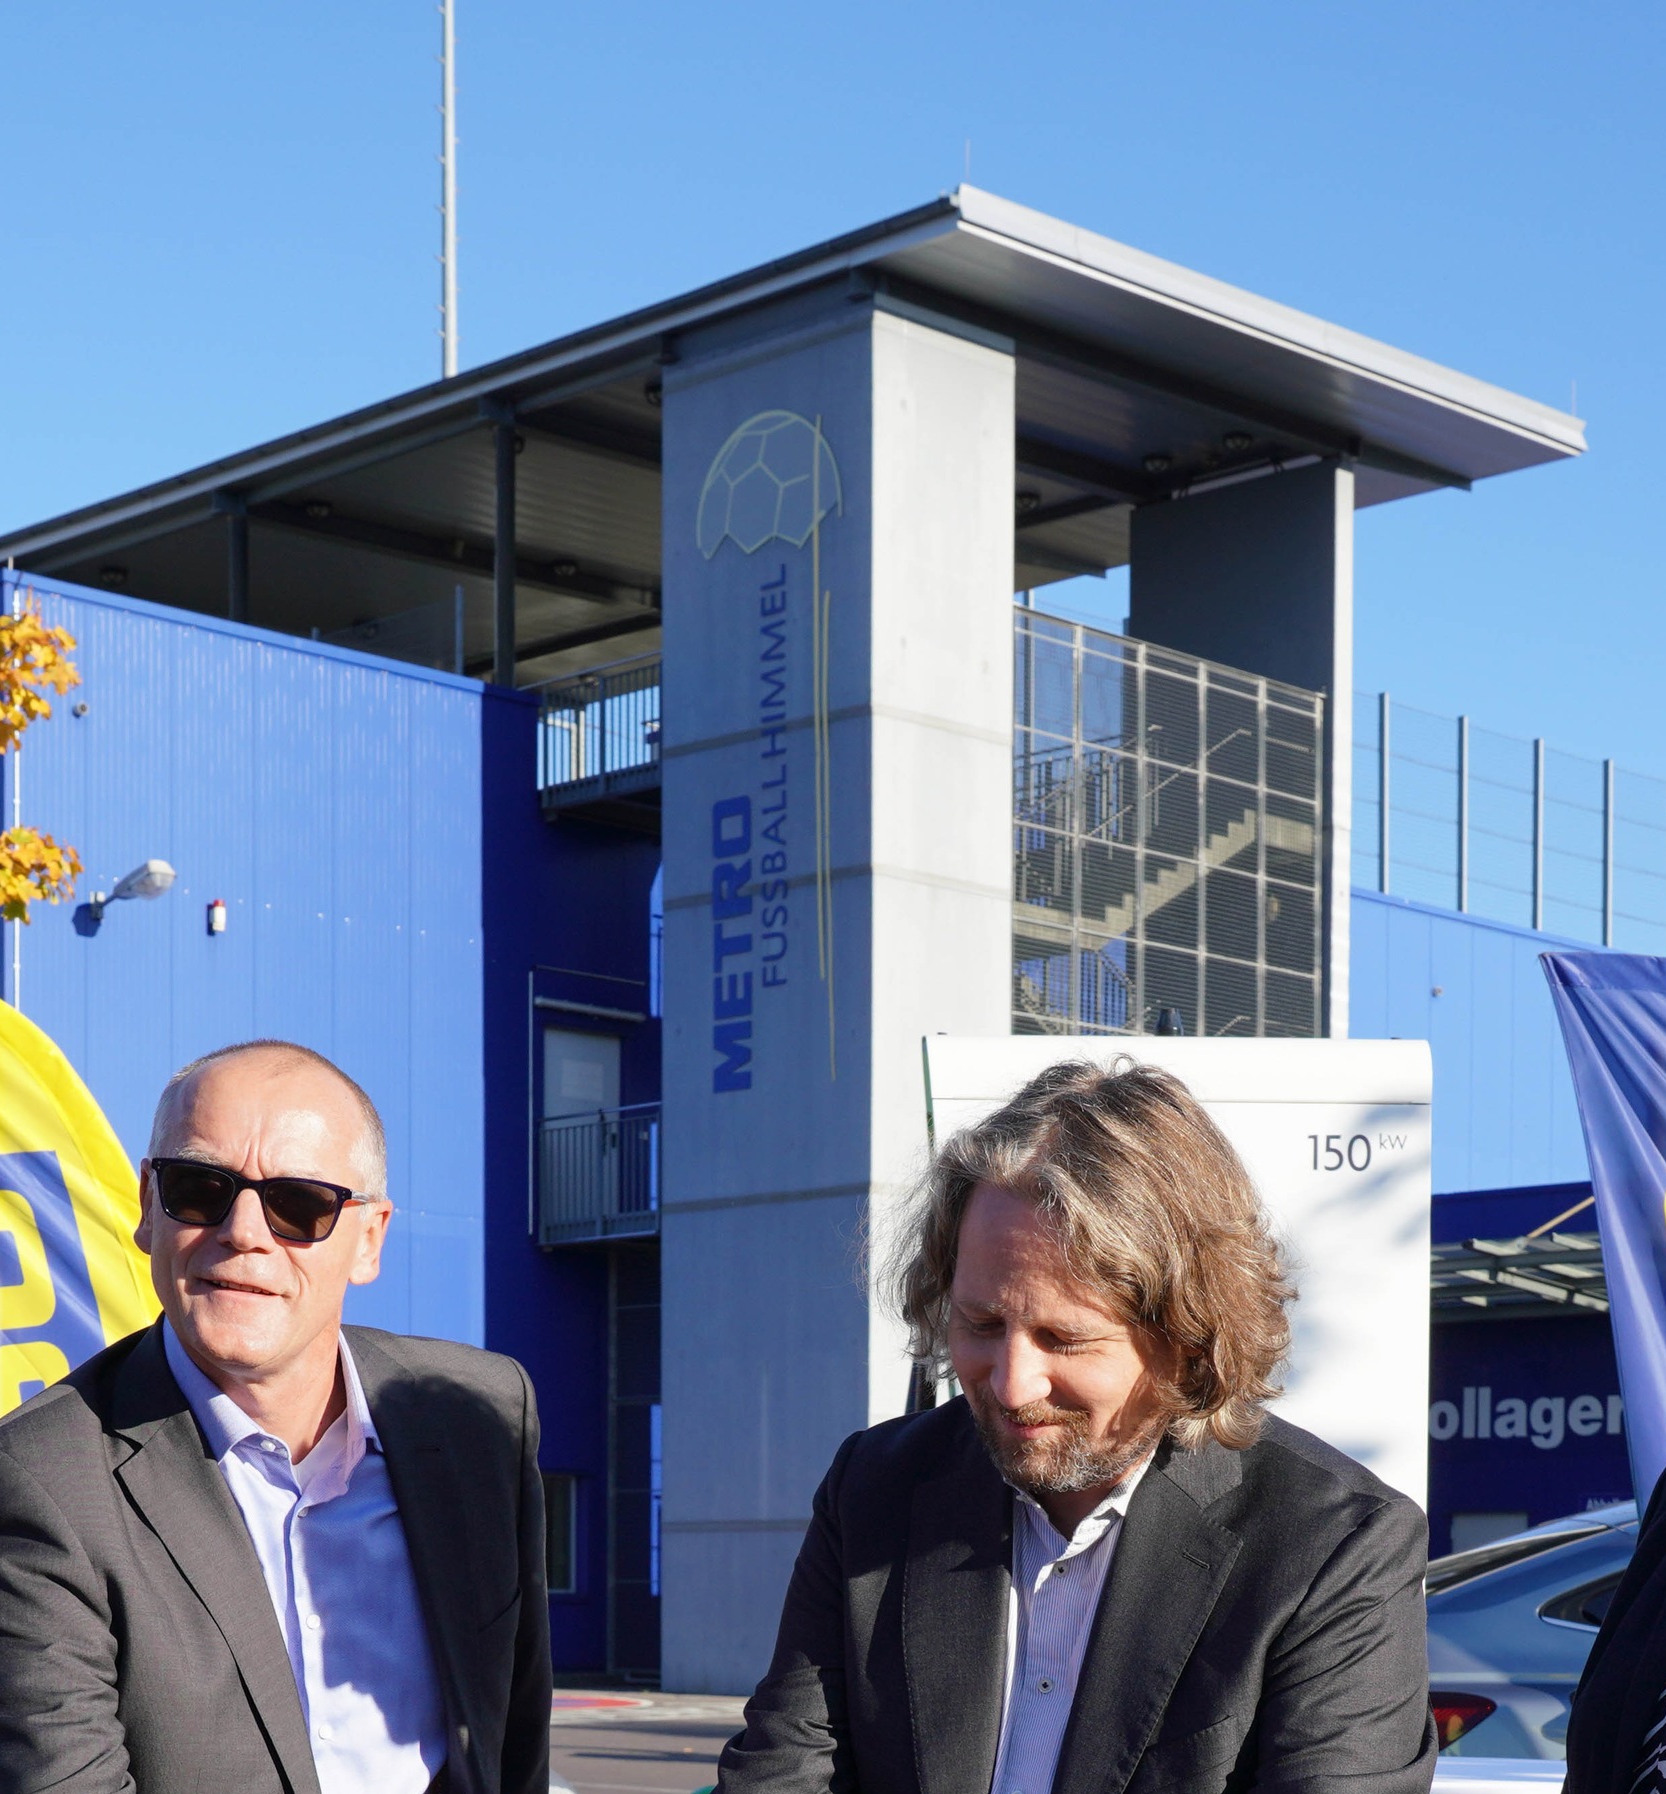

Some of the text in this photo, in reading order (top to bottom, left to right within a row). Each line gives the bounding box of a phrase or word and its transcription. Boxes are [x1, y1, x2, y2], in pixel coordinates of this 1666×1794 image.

[760, 563, 788, 988] FUSSBALLHIMMEL
[712, 794, 753, 1095] METRO
[1307, 1132, 1408, 1172] 150 kW
